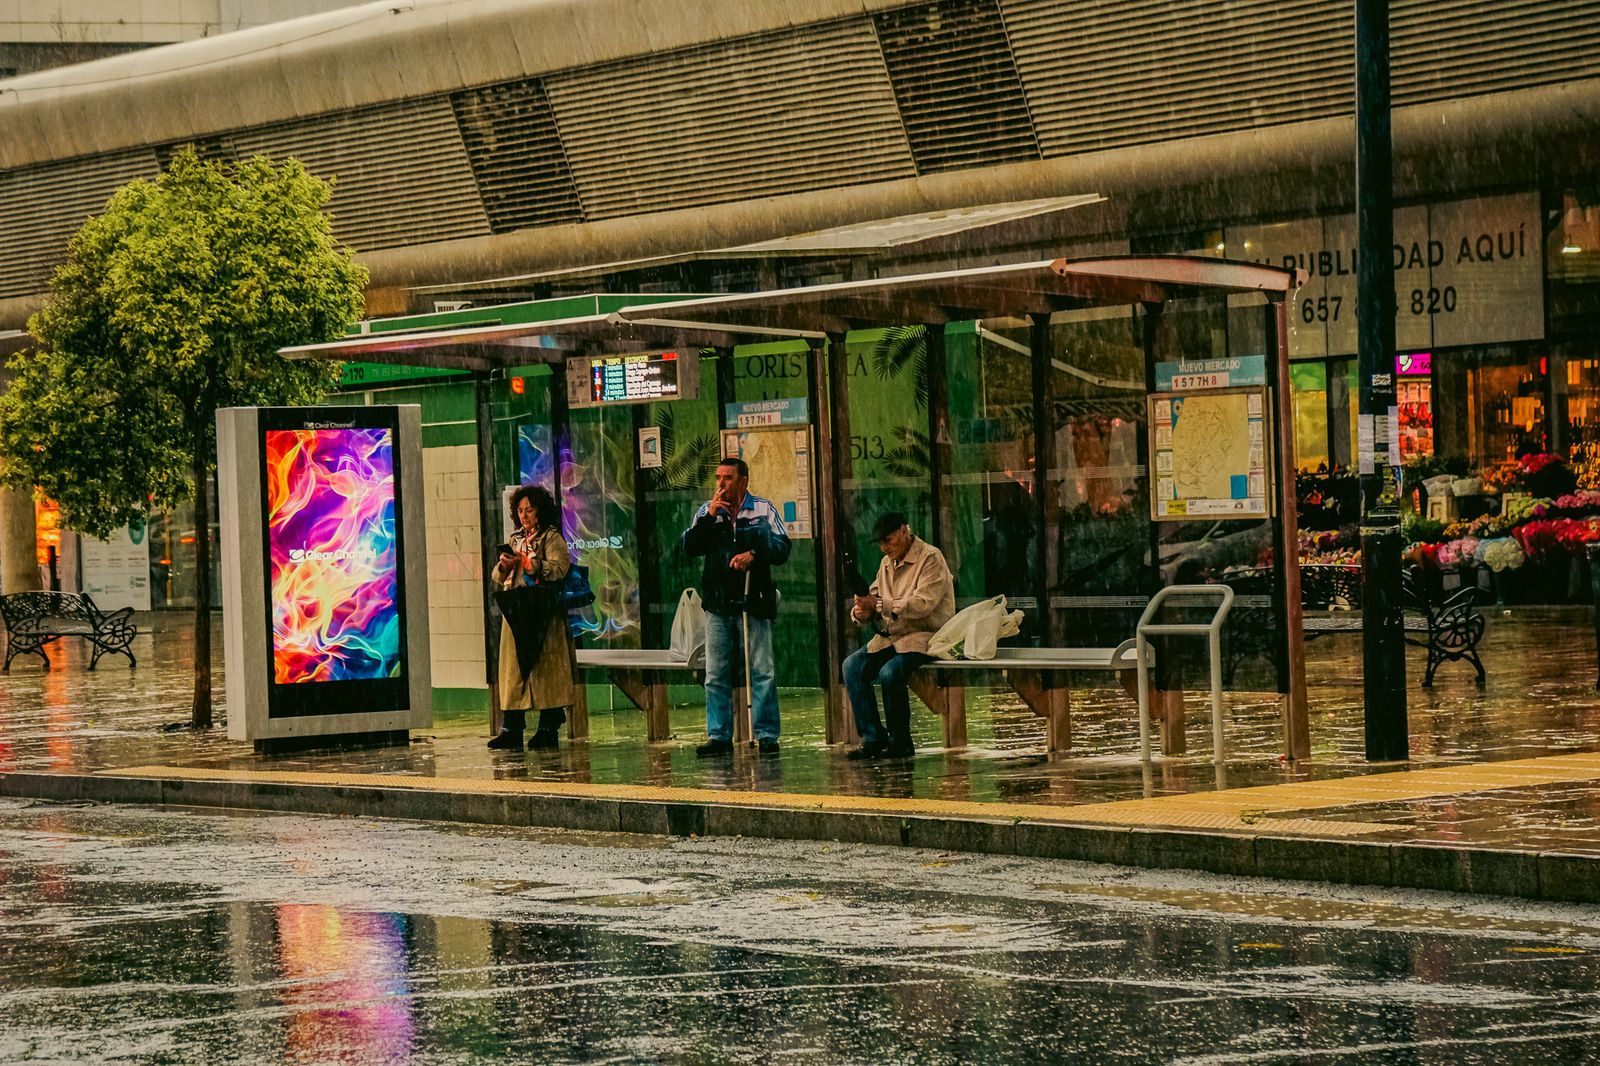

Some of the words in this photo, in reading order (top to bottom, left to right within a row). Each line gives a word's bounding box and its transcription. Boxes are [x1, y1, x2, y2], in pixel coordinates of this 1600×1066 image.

[1283, 240, 1444, 278] PUBLIDAD
[1456, 222, 1526, 264] AQUÍ
[1302, 296, 1343, 324] 657
[1410, 286, 1457, 316] 820
[1179, 362, 1203, 373] NUEVO
[1205, 360, 1240, 371] MERCADO
[1174, 379, 1178, 388] 1
[1181, 378, 1187, 387] 5
[1189, 377, 1195, 386] 7
[1197, 376, 1209, 386] 7H
[1211, 375, 1217, 385] 8
[743, 403, 761, 413] NUEVO
[762, 401, 789, 411] MERCADO
[745, 416, 750, 424] 5
[751, 416, 755, 424] 7
[757, 415, 766, 424] 7H
[767, 414, 772, 423] 8
[306, 549, 333, 561] Clear
